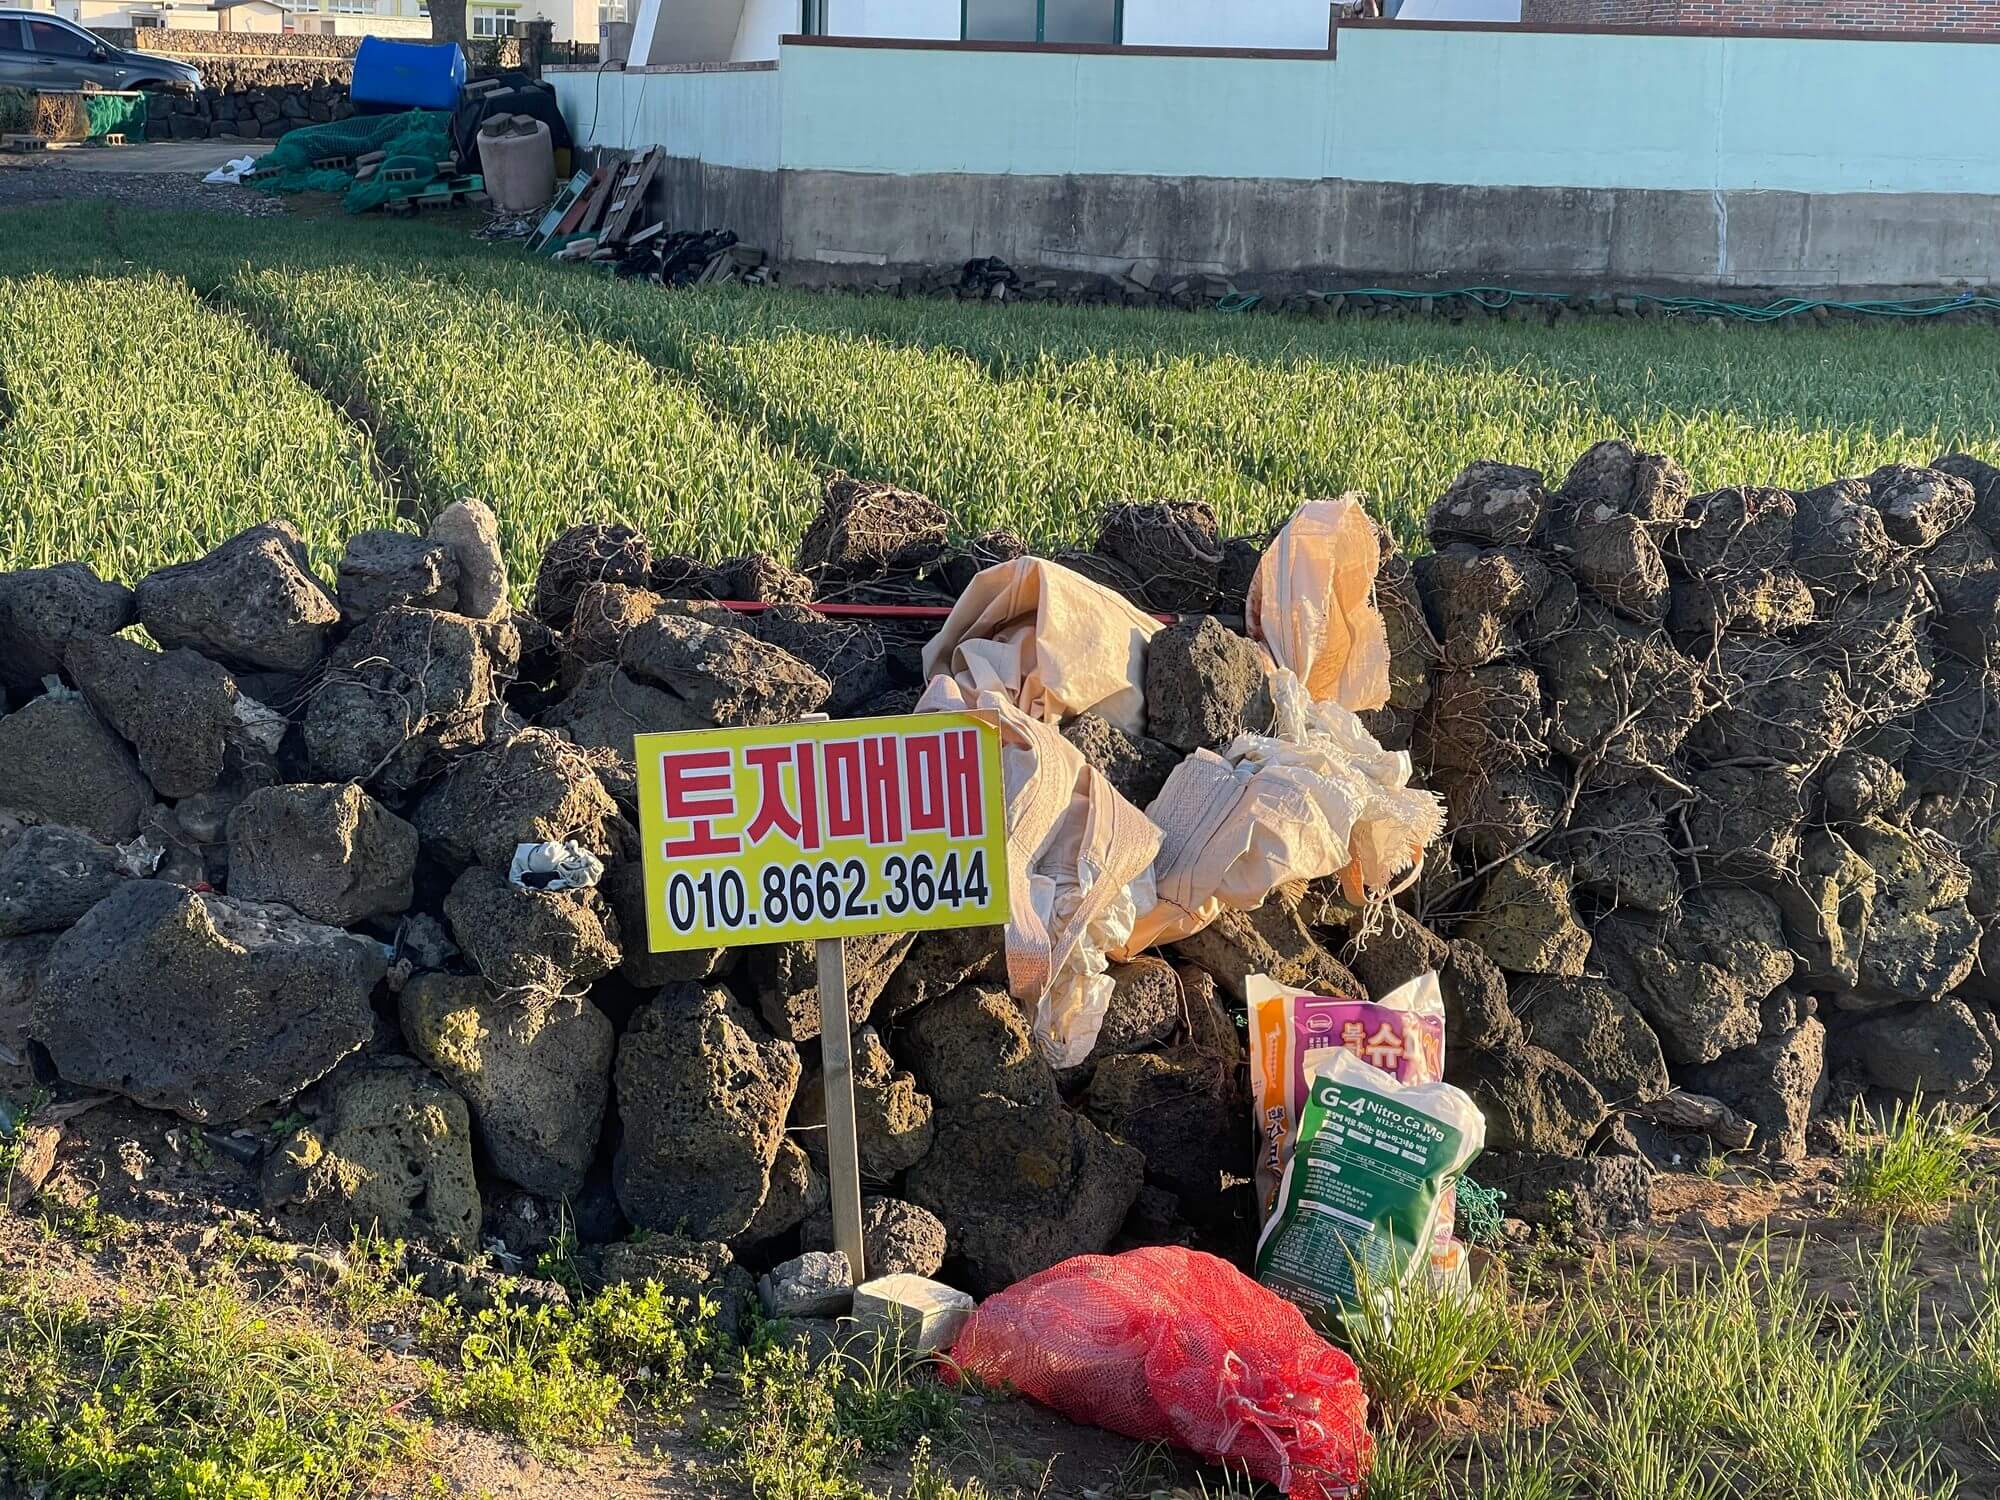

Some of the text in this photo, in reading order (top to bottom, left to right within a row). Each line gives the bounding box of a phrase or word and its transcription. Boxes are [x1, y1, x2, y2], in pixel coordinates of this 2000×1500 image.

[662, 729, 985, 858] 토지매매
[668, 850, 989, 932] 010.8662.3644
[1319, 1087, 1445, 1142] G-4 Nitro Ca Mg
